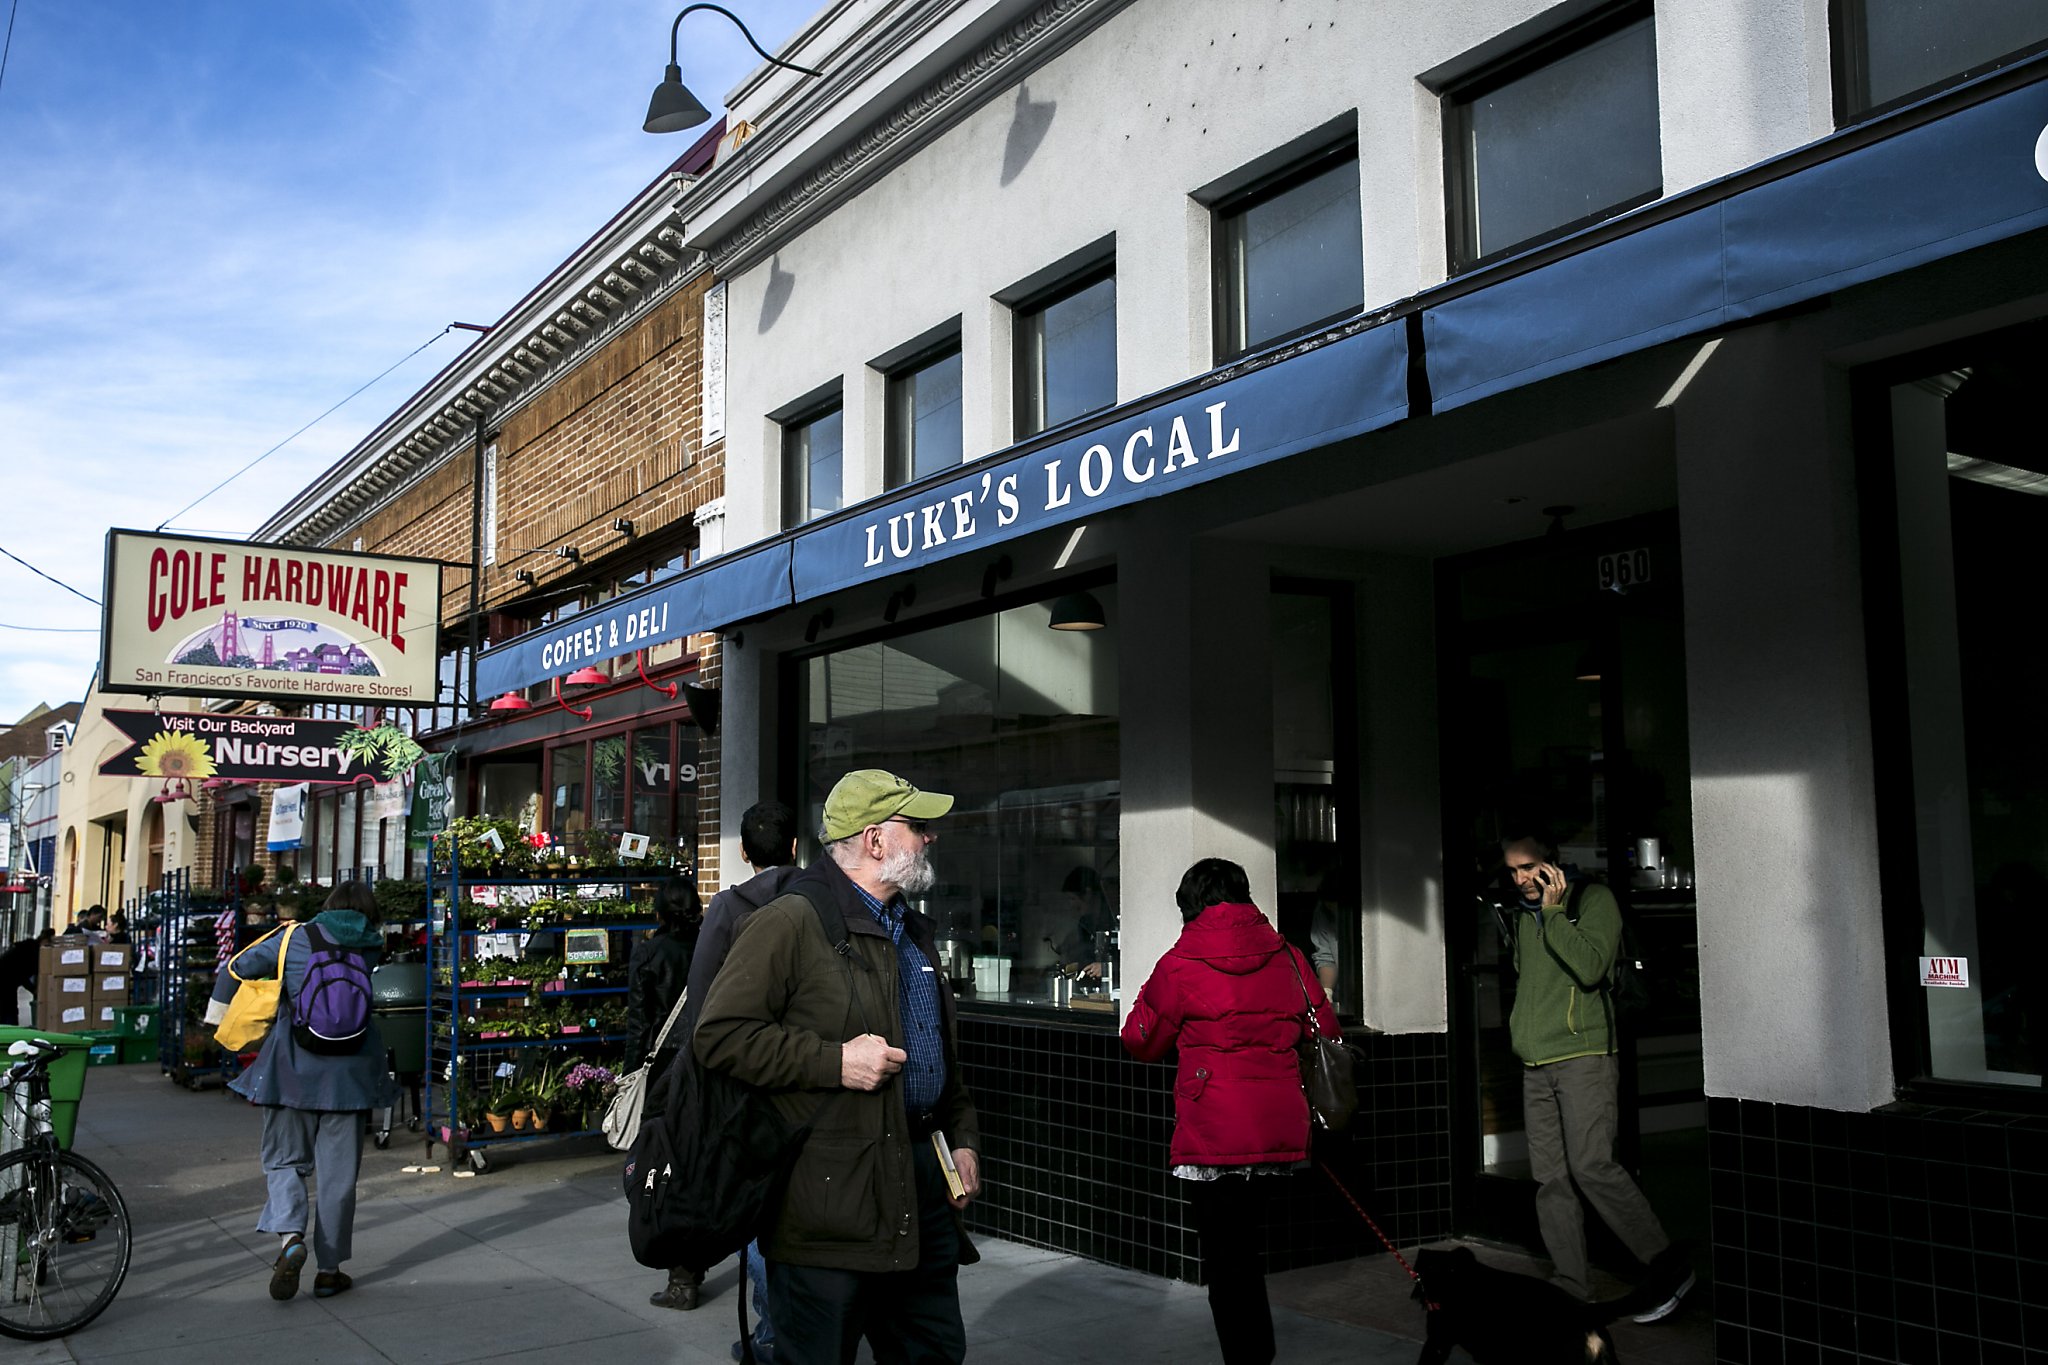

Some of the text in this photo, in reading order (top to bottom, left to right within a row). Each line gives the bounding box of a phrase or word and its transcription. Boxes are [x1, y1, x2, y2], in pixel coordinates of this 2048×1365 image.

[864, 401, 1240, 568] LUKE'S LOCAL
[1600, 549, 1649, 588] 960
[147, 547, 409, 655] COLE HARDWARE
[252, 620, 308, 630] SINCE 1920
[542, 601, 669, 670] COFFEE & DELI
[135, 668, 413, 697] San Francisco's Favorite Hardware Stores!
[162, 716, 295, 737] Visit Our Backyard
[215, 737, 356, 775] Nursery
[1928, 958, 1959, 974] ATM
